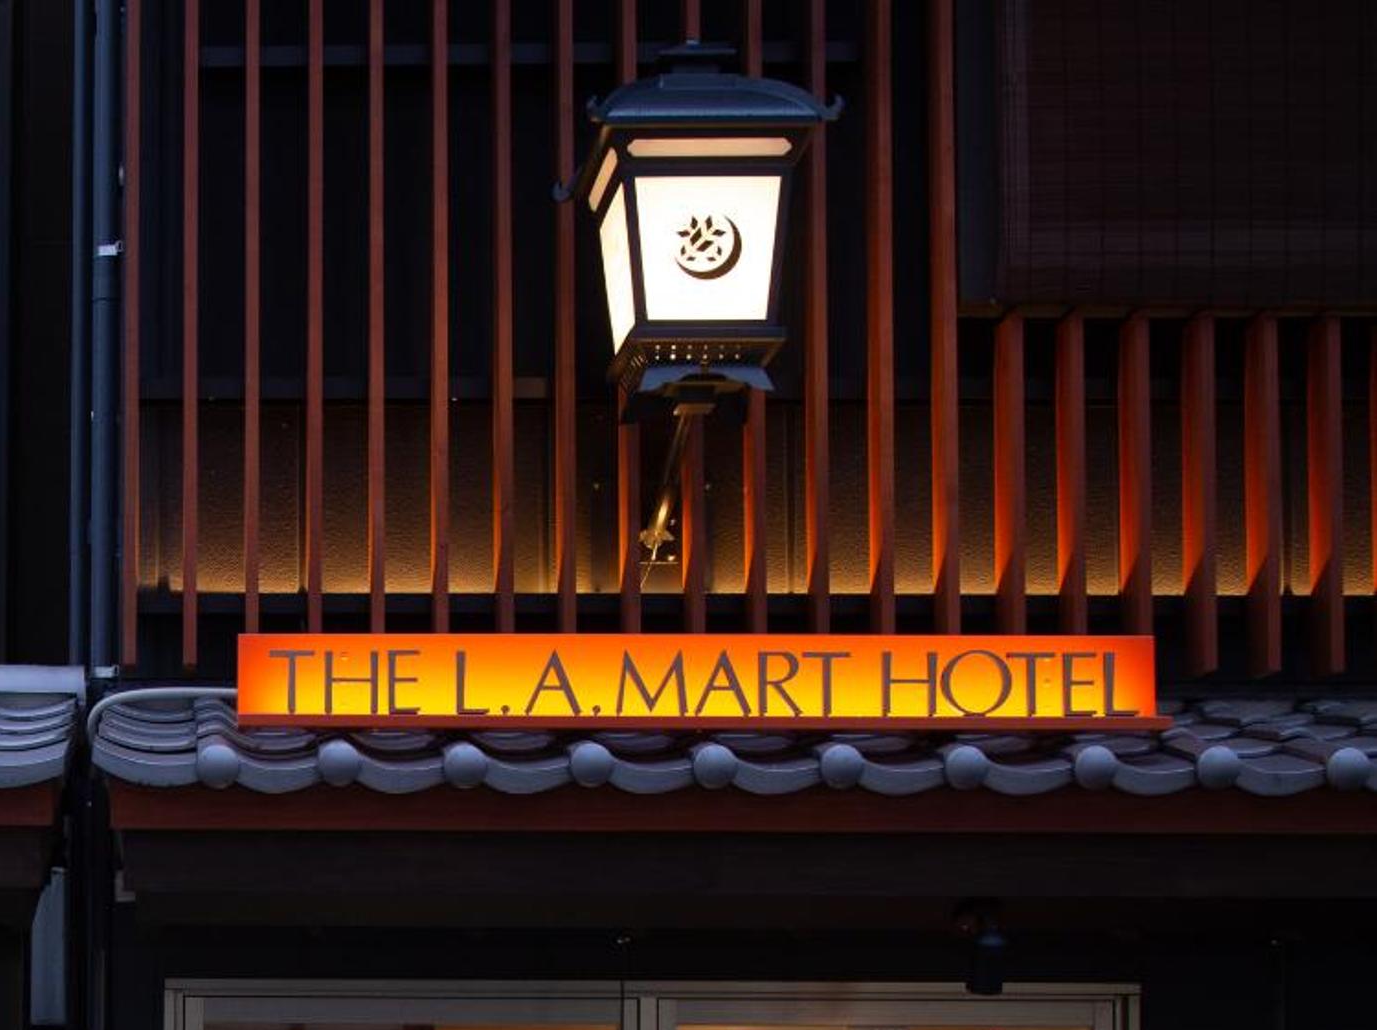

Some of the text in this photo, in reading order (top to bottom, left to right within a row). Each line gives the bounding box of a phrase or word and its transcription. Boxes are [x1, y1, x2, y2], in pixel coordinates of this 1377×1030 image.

[269, 649, 1140, 717] THE L.A.MART HOTEL
